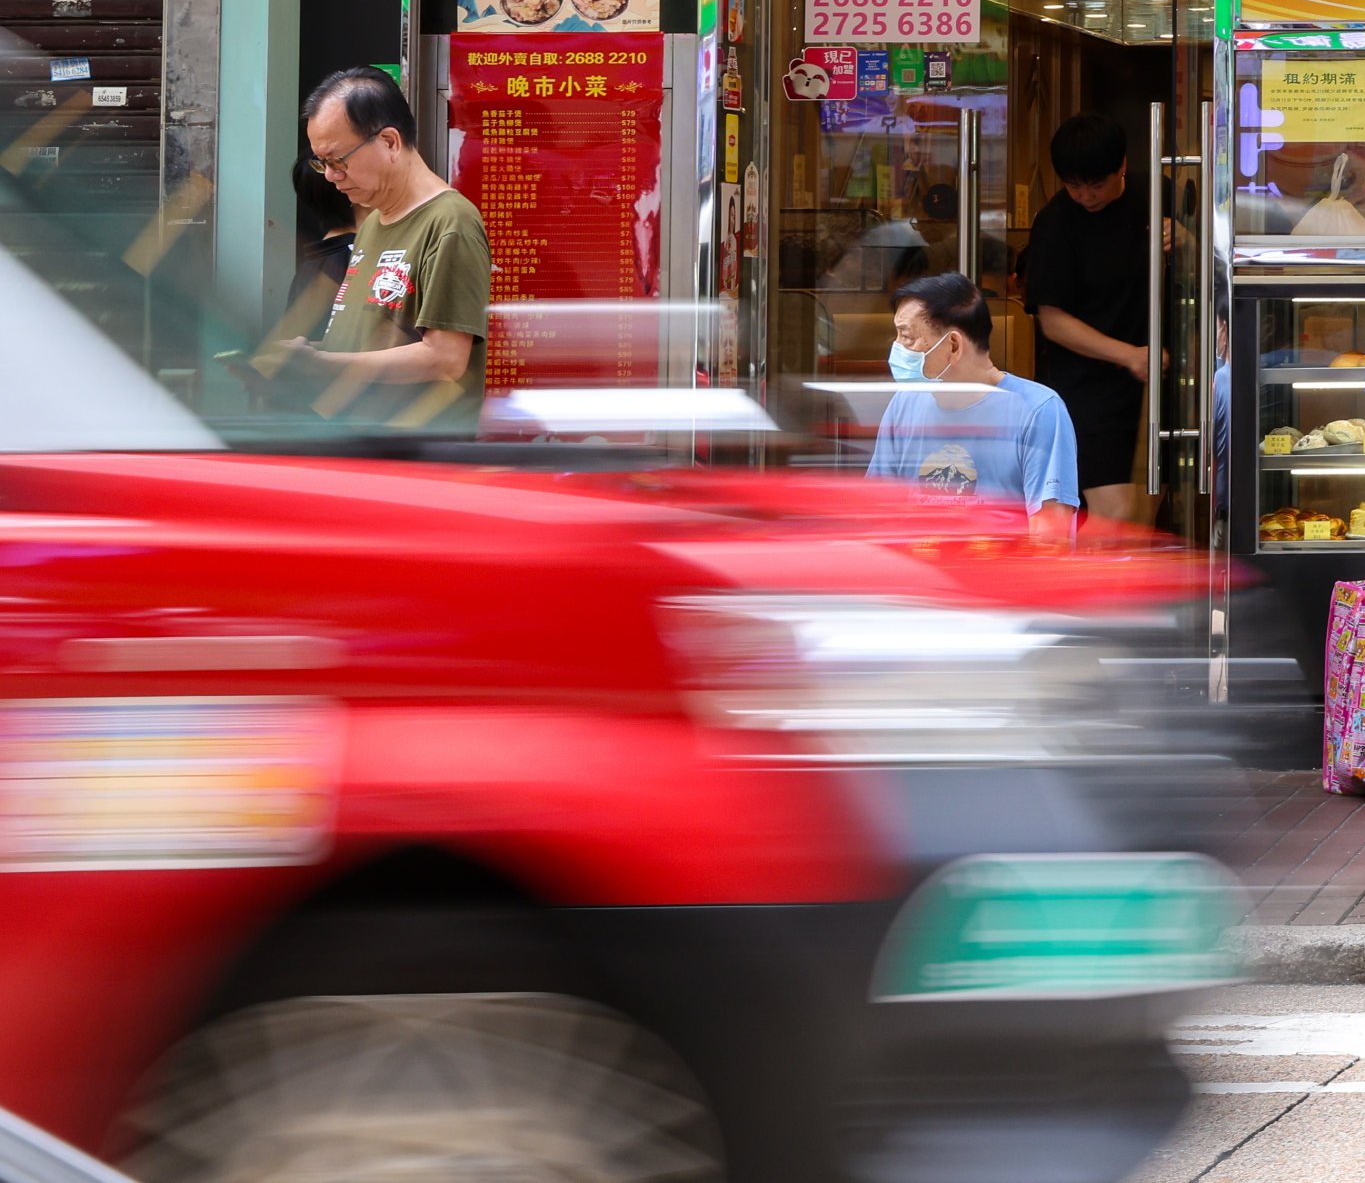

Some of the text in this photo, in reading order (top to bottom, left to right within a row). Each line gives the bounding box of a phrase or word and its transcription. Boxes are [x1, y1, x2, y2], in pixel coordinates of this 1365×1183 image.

[813, 12, 972, 36] 2725 6386
[565, 52, 604, 65] 2688
[608, 52, 647, 65] 2210
[824, 51, 852, 64] 現已
[832, 65, 854, 75] 加盟
[1283, 73, 1356, 85] 租約期滿
[507, 75, 608, 98] 晚市小菜
